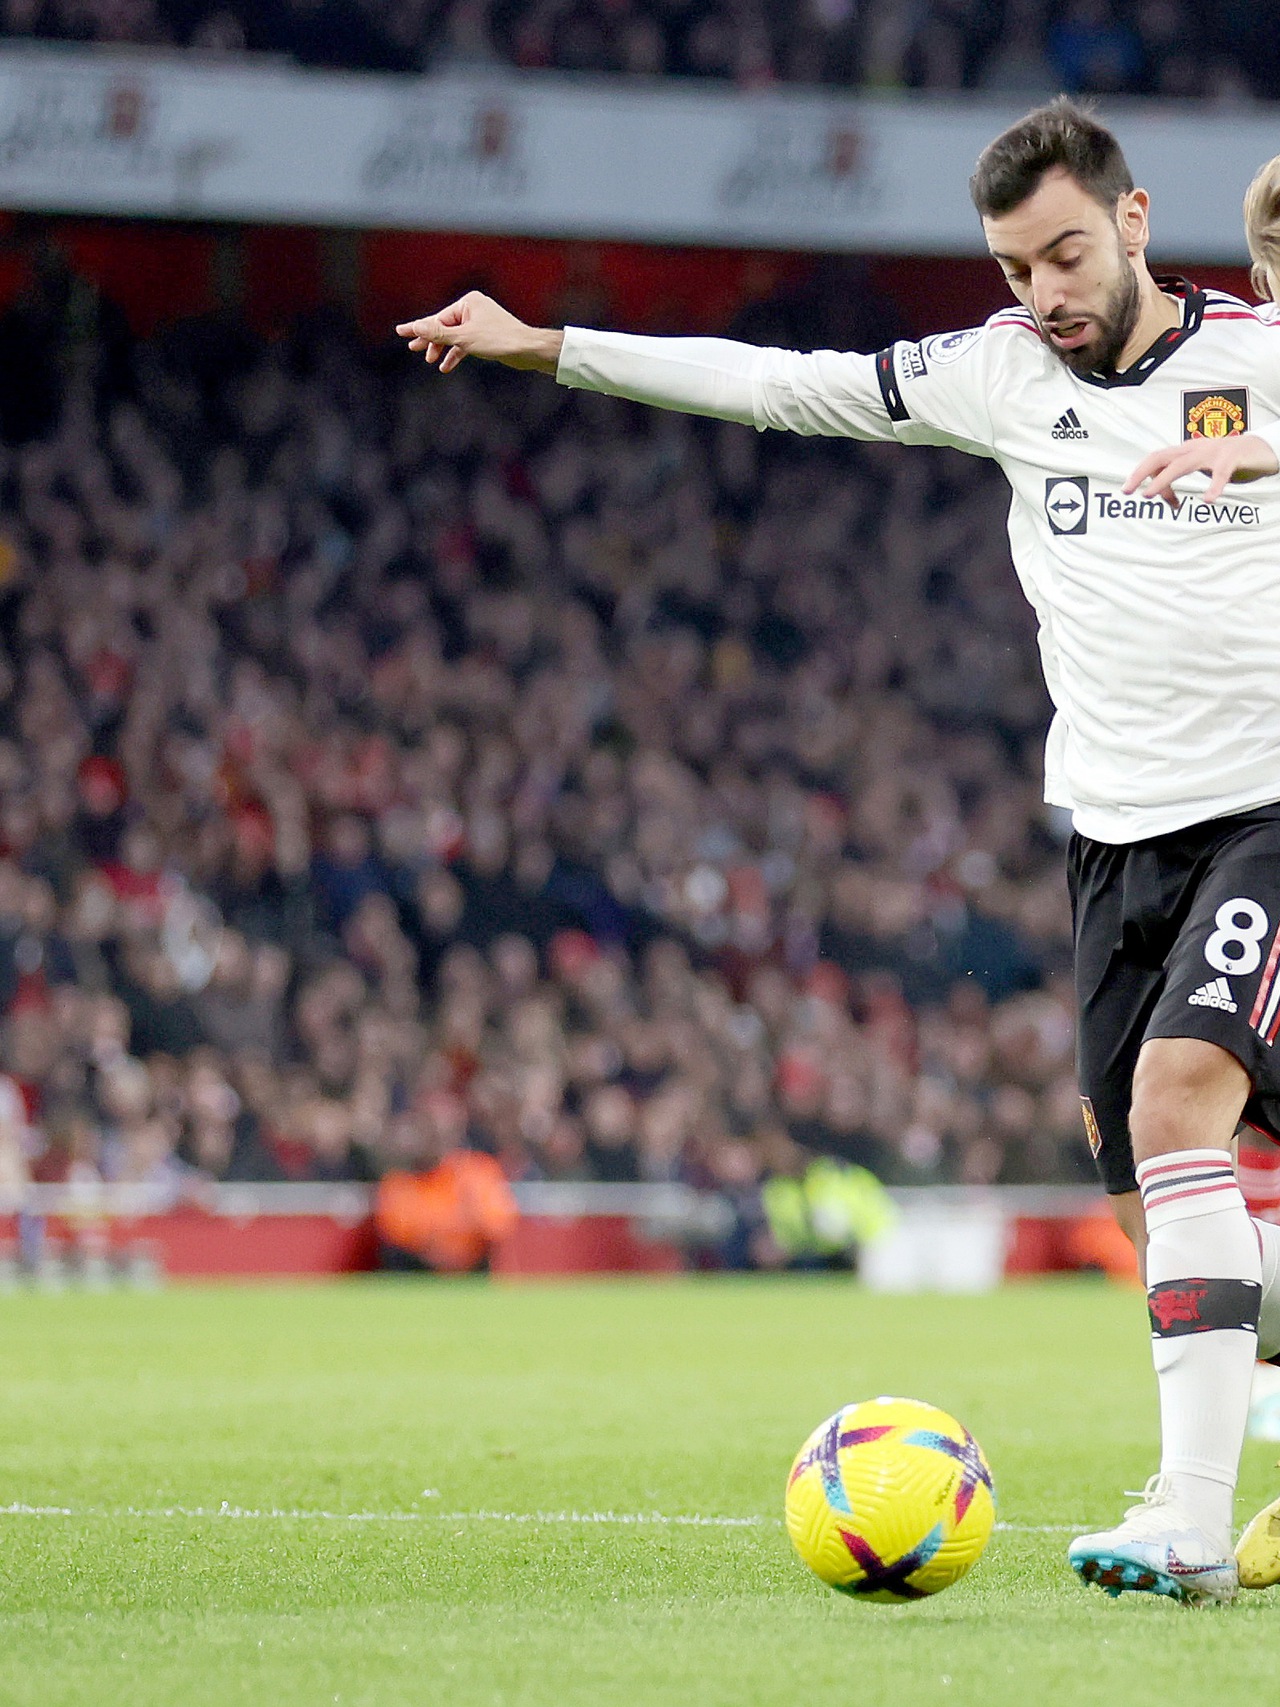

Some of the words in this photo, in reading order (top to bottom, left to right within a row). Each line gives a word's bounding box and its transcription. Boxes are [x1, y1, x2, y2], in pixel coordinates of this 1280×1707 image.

[1051, 427, 1089, 440] adidas
[1094, 493, 1260, 525] TeamViewer
[1204, 897, 1270, 976] 8
[1187, 992, 1238, 1014] adidas
